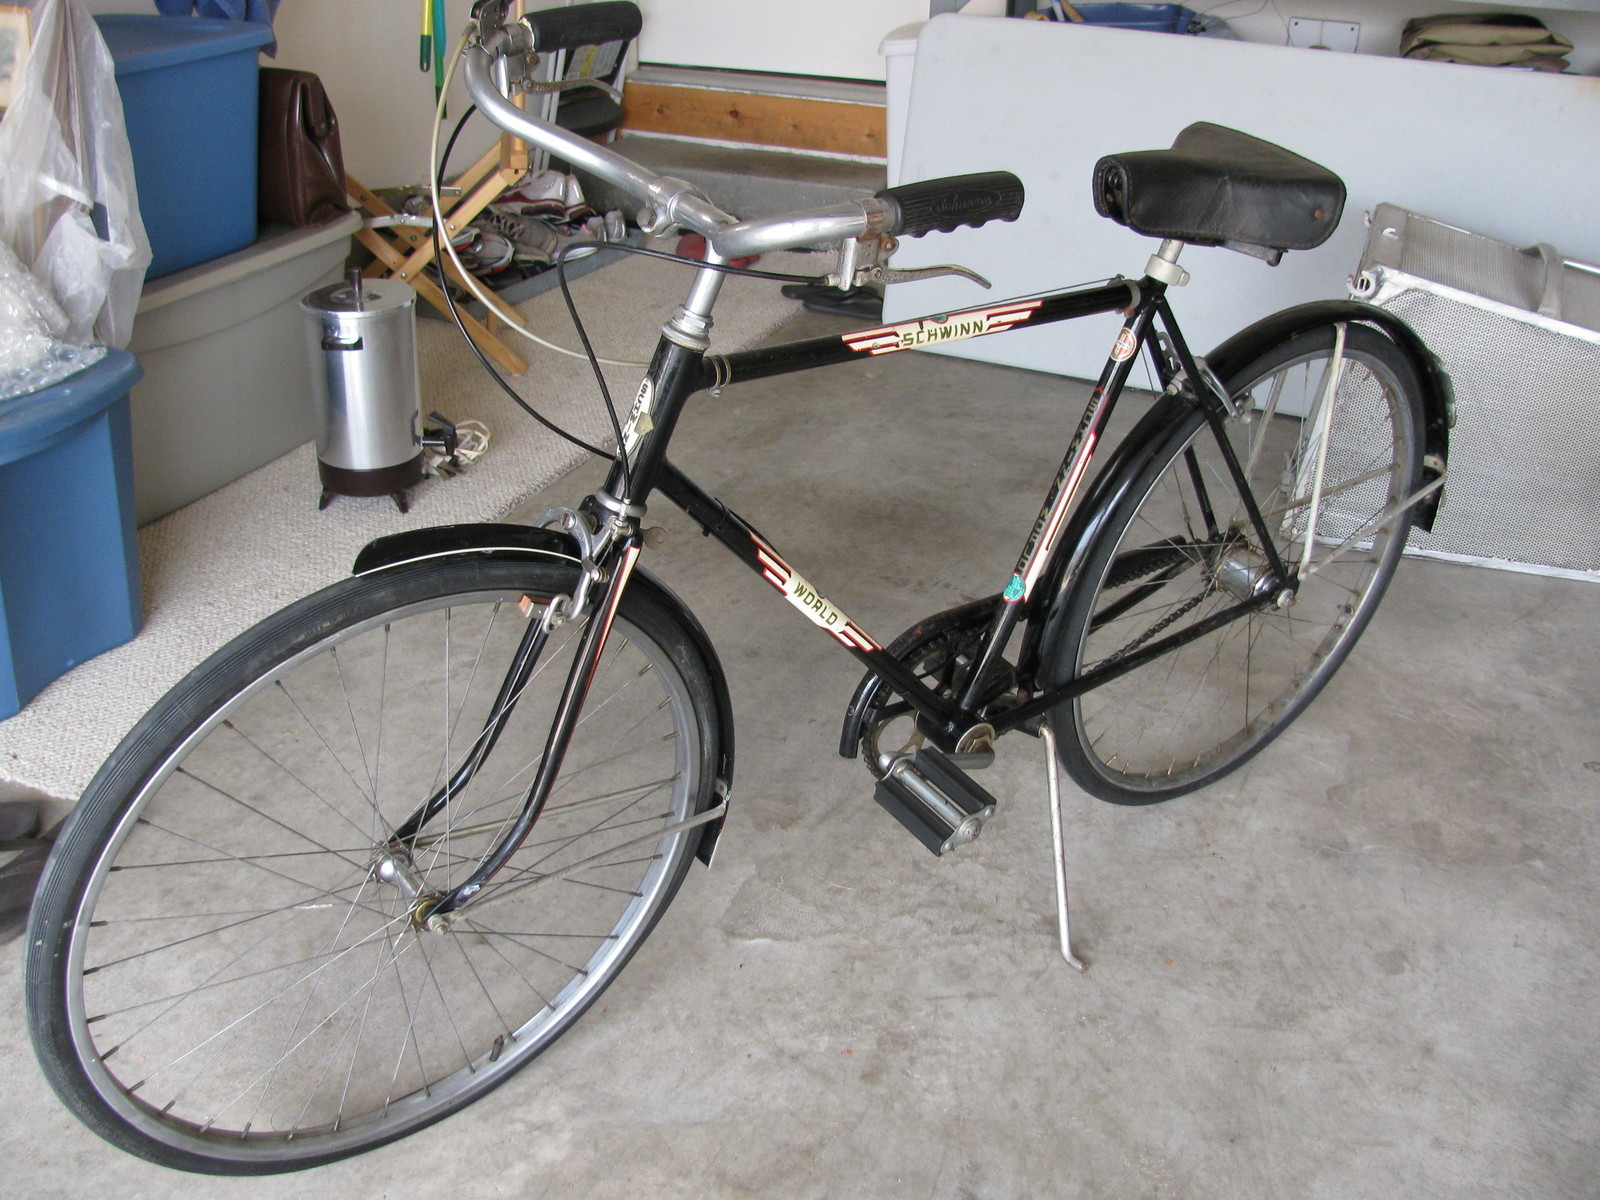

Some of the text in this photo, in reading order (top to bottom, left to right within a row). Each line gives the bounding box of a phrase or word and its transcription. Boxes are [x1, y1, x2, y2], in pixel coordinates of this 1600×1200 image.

[903, 320, 983, 346] SCHWINN
[619, 383, 648, 450] SCHWIN
[793, 581, 838, 626] WORLD
